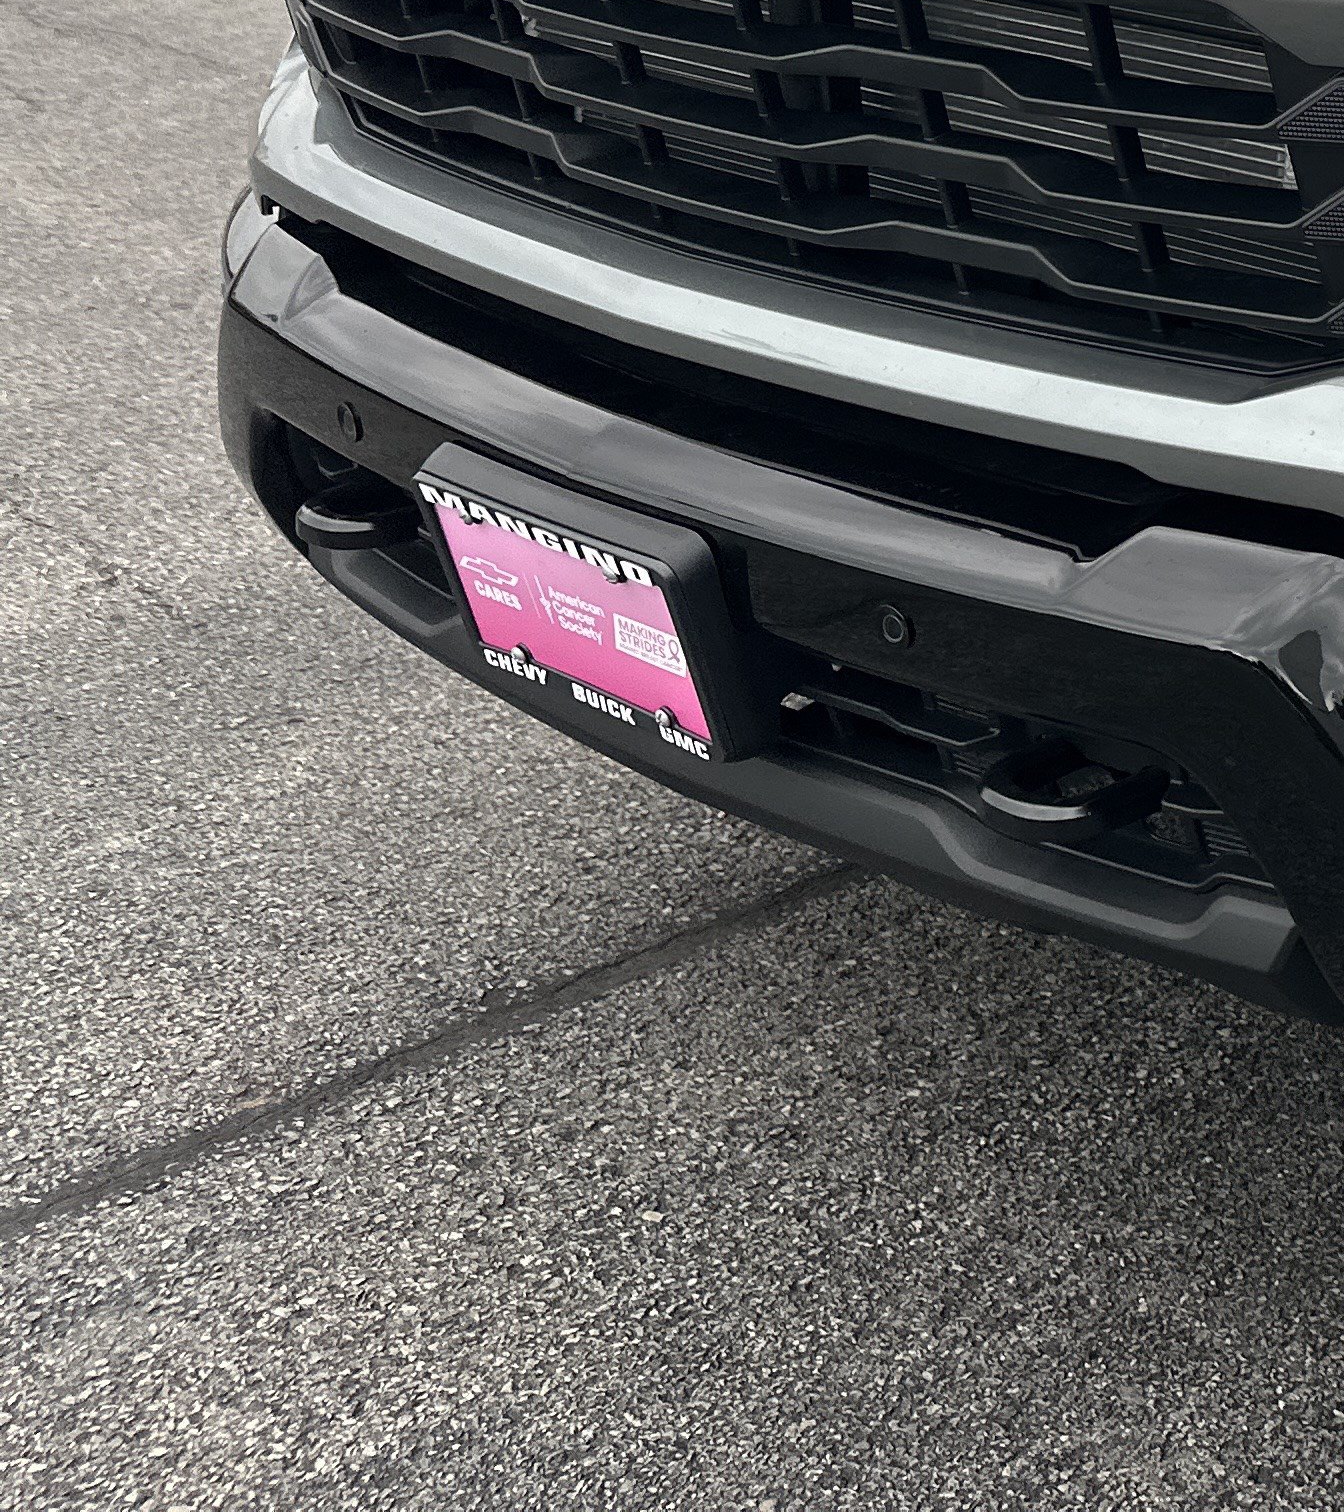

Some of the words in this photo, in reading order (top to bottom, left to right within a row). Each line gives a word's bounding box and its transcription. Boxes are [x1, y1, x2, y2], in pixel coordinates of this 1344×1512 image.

[418, 483, 653, 587] MANGINO
[473, 580, 523, 611] CARES
[548, 586, 605, 618] American
[552, 600, 596, 626] Cancer
[557, 615, 603, 646] Society
[617, 617, 666, 646] MAKING
[618, 630, 667, 659] STRIDES
[483, 648, 547, 685] CHEVY
[571, 682, 636, 726] BUICK
[659, 724, 710, 761] GMC
